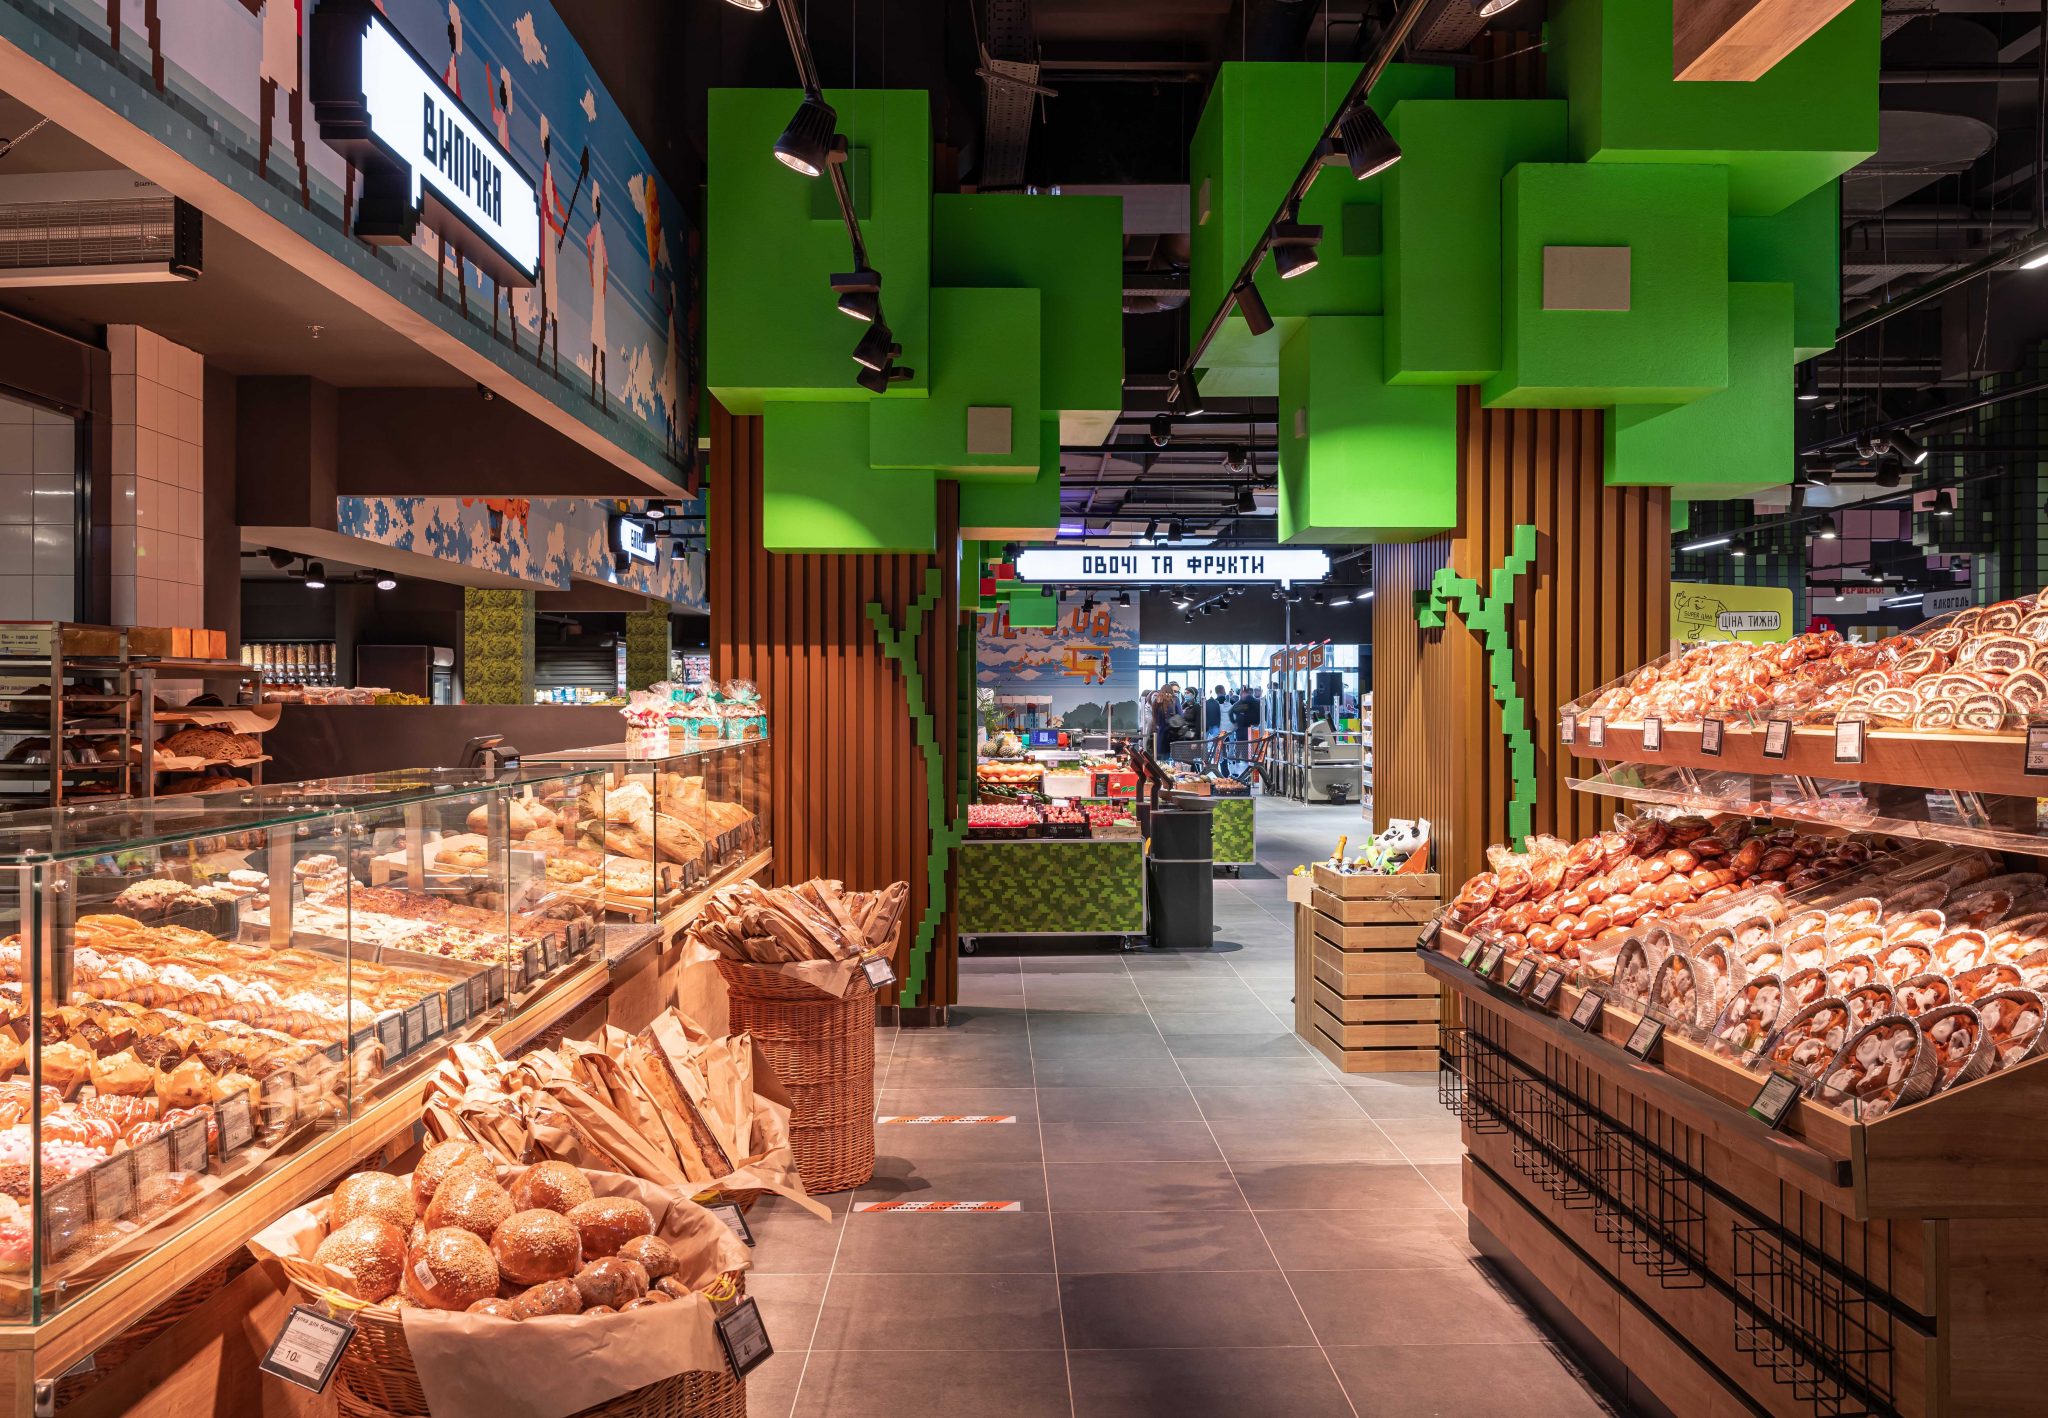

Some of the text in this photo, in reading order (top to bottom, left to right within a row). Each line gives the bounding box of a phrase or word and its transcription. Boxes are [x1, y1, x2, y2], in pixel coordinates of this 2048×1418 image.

[424, 92, 501, 227] ВИПІЧКА
[1083, 556, 1264, 574] ОВОЧІ ТА ФРУКТИ
[1933, 596, 1969, 609] АЛКОГОЛЬ
[1722, 613, 1778, 629] ЦІНА ТИЖНЯ
[1298, 655, 1307, 664] 12
[1312, 654, 1321, 663] 13
[285, 1350, 297, 1362] 10
